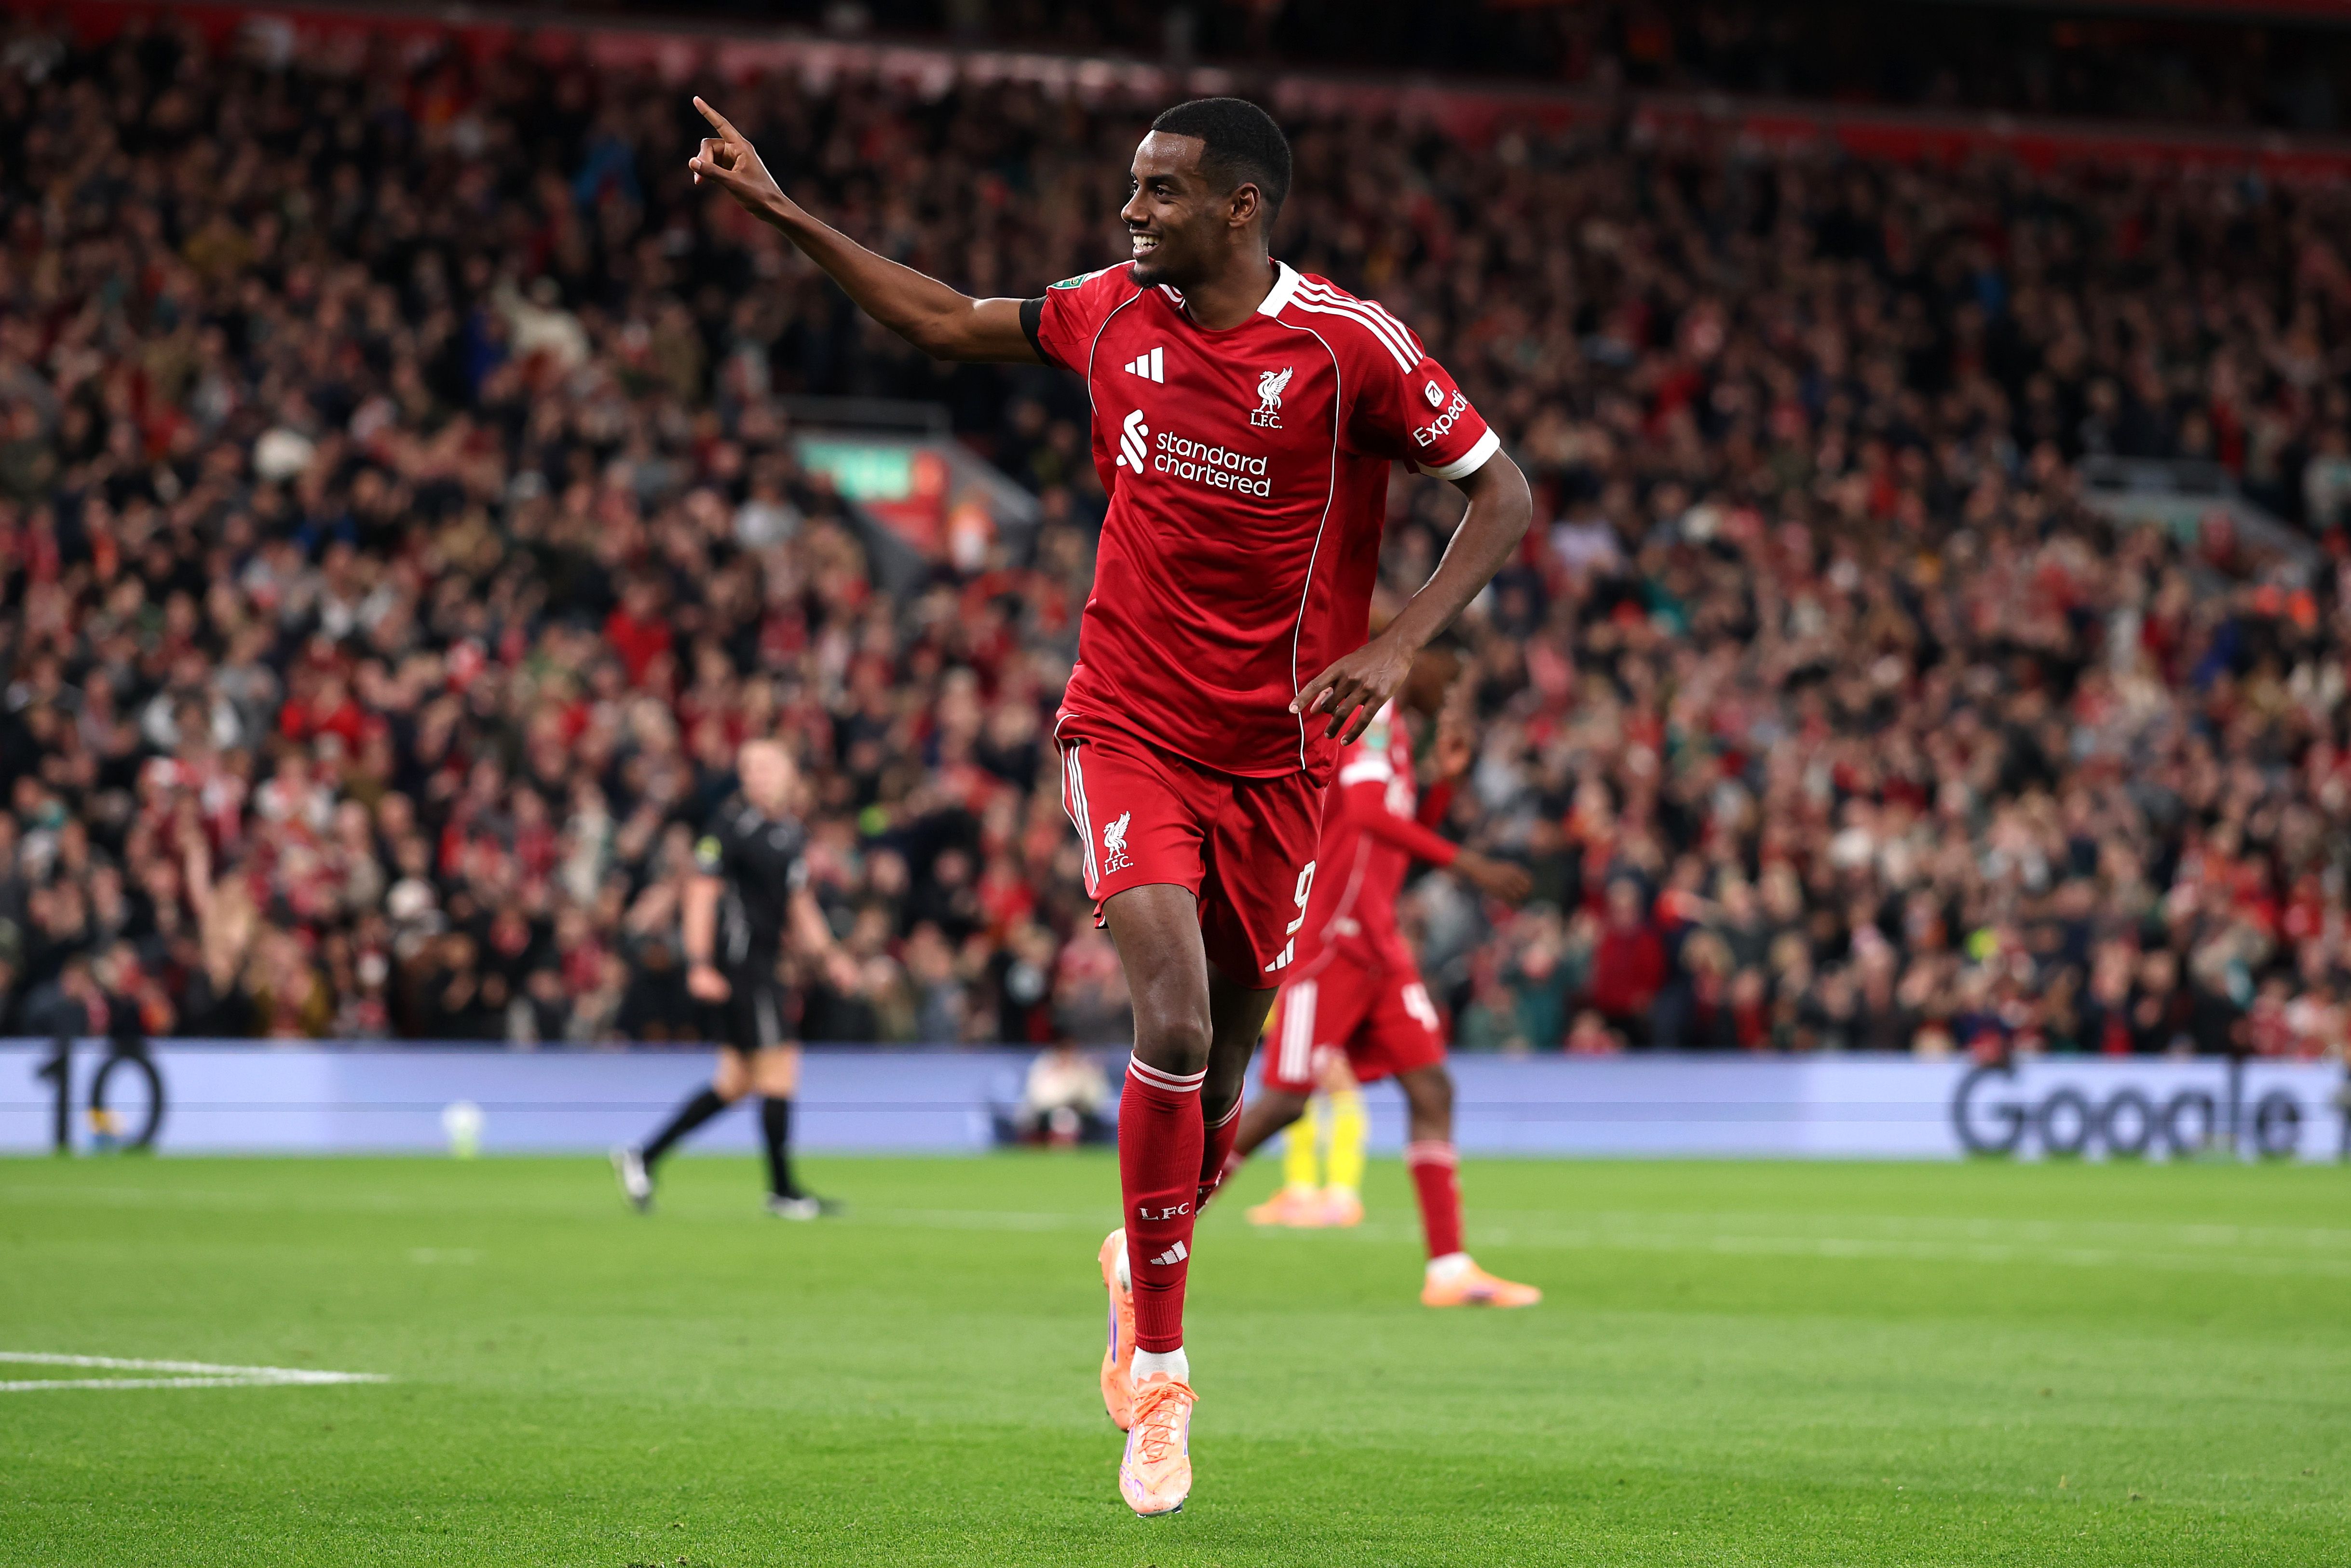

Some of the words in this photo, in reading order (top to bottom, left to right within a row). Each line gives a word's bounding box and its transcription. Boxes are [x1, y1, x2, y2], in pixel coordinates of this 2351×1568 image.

[1250, 413, 1283, 429] L.F.C.
[1155, 453, 1271, 497] chartered
[1156, 431, 1267, 475] standard
[1104, 856, 1133, 876] L.F.C.
[1286, 860, 1316, 936] 9
[35, 1037, 165, 1154] 10
[1954, 1052, 2299, 1155] Google
